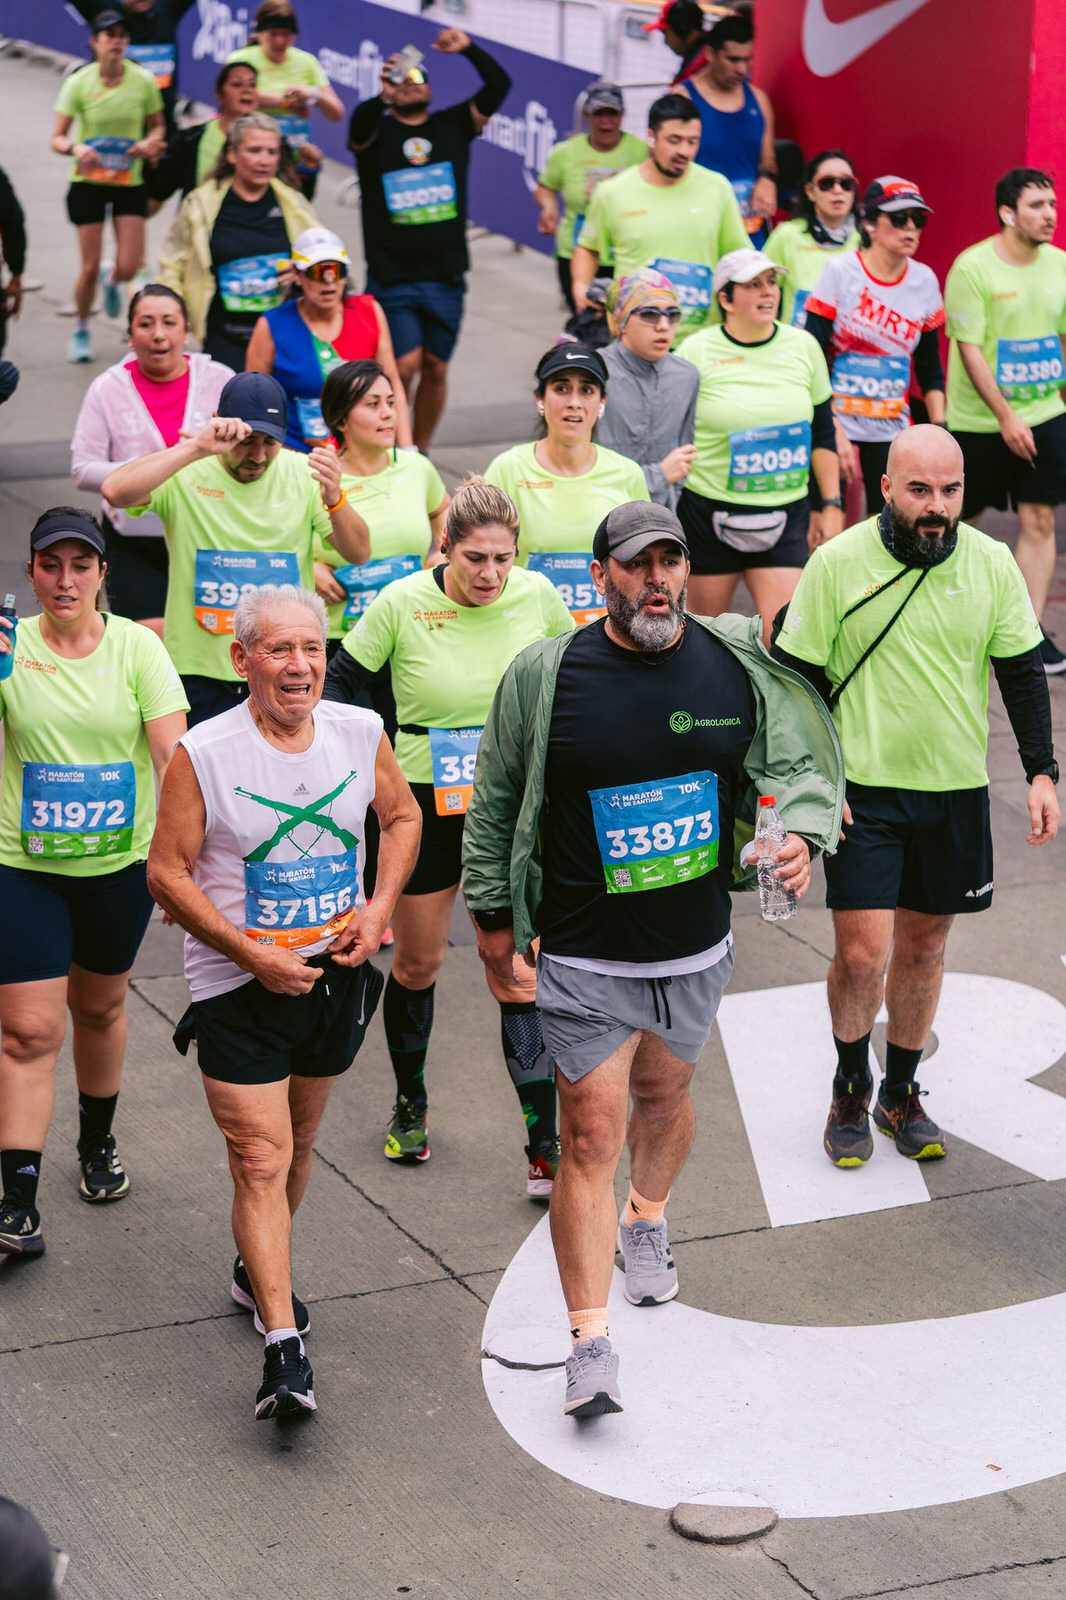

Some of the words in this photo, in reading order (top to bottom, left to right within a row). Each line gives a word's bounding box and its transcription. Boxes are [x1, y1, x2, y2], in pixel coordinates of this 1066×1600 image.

[733, 445, 808, 475] 32094
[694, 717, 741, 727] AGROLOGICA
[48, 770, 85, 779] MARATÓN
[100, 770, 120, 782] 10K
[622, 789, 663, 802] MARATÓN
[678, 780, 701, 795] 10K
[632, 795, 664, 806] SANTIAGO
[31, 799, 126, 828] 31972
[605, 810, 713, 858] 33873
[279, 867, 315, 878] MARATÓN
[288, 873, 315, 883] SANTIAGO
[257, 886, 350, 926] 37156
